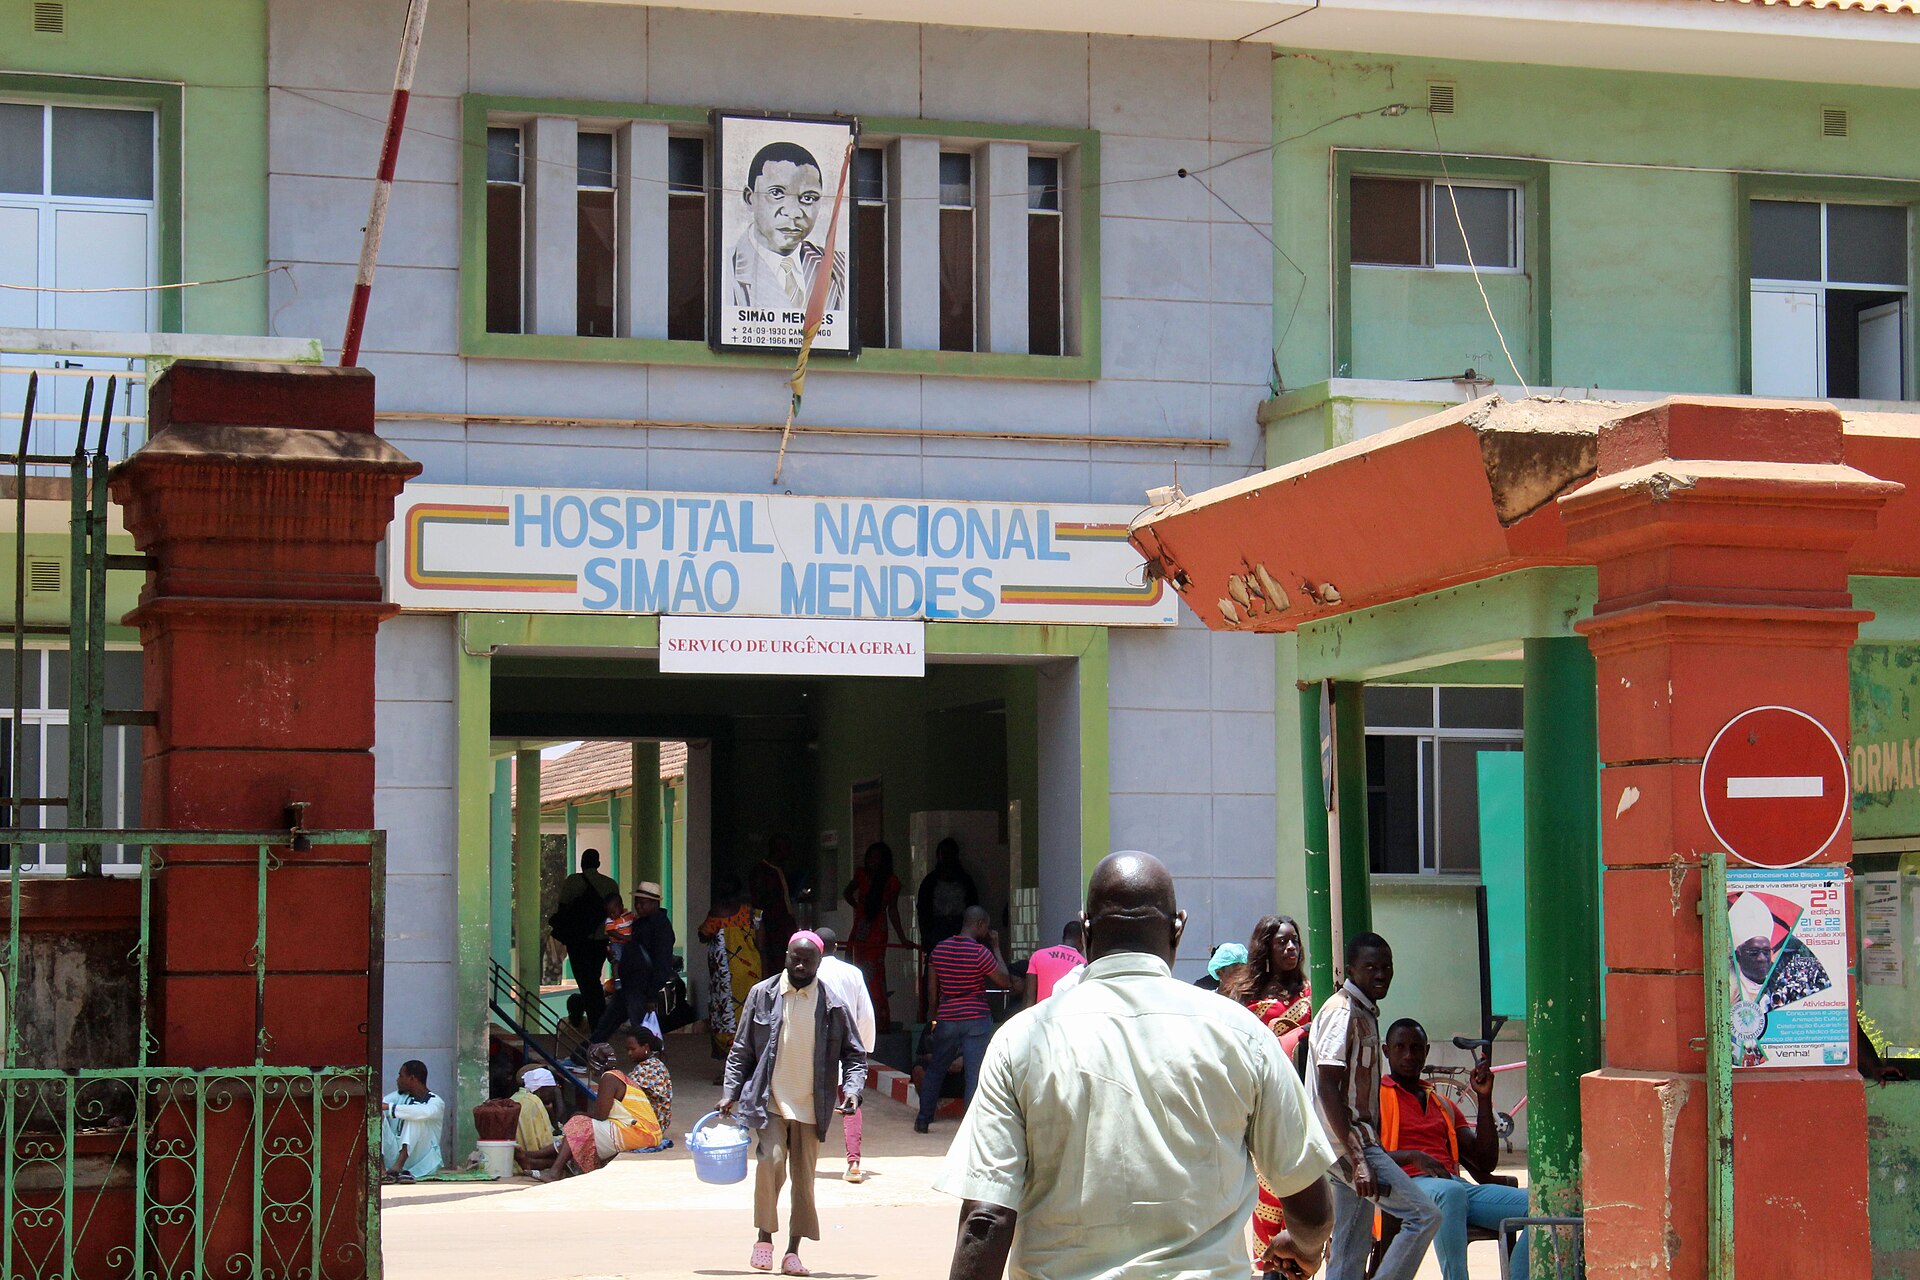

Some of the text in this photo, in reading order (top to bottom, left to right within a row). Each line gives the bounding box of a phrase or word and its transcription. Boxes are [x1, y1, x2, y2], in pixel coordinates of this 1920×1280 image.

[738, 309, 834, 325] SIMÃO MENS
[788, 329, 832, 337] CANNGO
[514, 493, 1071, 561] HOSPITAL NACIONAL
[582, 551, 996, 618] SIMÃO MENDES
[668, 635, 916, 655] SERVIÇO DE URGÊNCIA GERAL
[1800, 871, 1820, 879] Bispo
[1810, 907, 1840, 917] edição
[1800, 918, 1811, 927] 21
[1825, 917, 1840, 926] 22
[1805, 938, 1841, 946] Bissau
[1803, 1000, 1846, 1008] Atividades
[1775, 1049, 1811, 1058] Venha!
